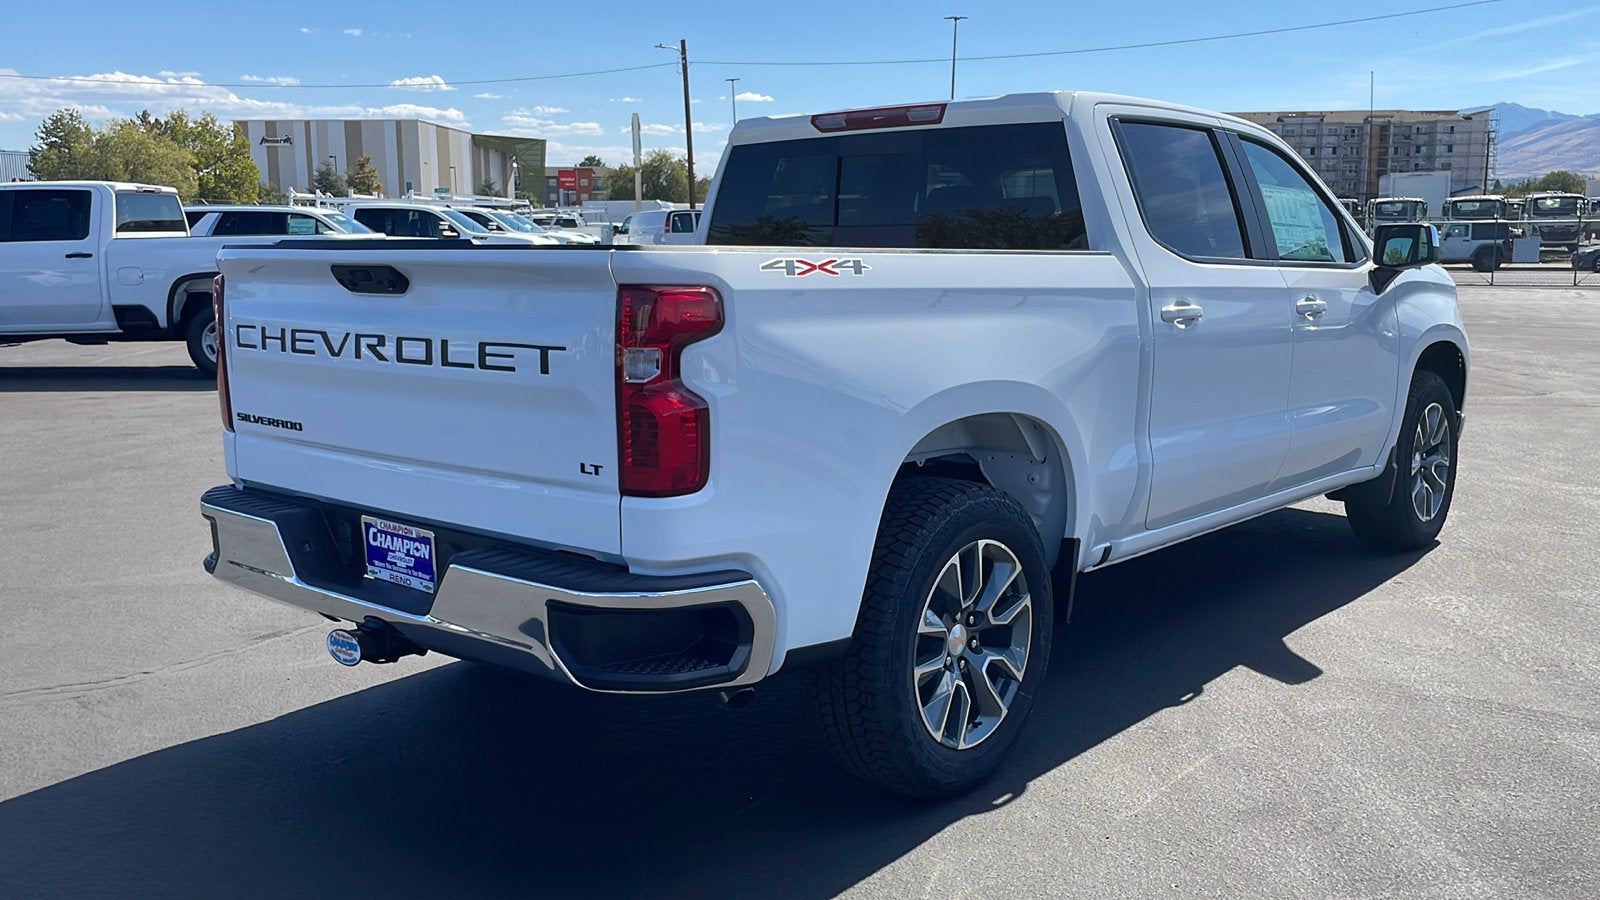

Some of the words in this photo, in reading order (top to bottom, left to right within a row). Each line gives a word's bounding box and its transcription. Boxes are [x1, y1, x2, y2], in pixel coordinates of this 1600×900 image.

[760, 258, 872, 276] 4X4
[236, 324, 567, 375] CHEVROLET
[236, 412, 303, 431] SILVERADO
[580, 462, 604, 476] LT
[379, 521, 413, 536] CHAMPION
[368, 527, 430, 559] CHAMPION
[389, 573, 412, 586] RENO
